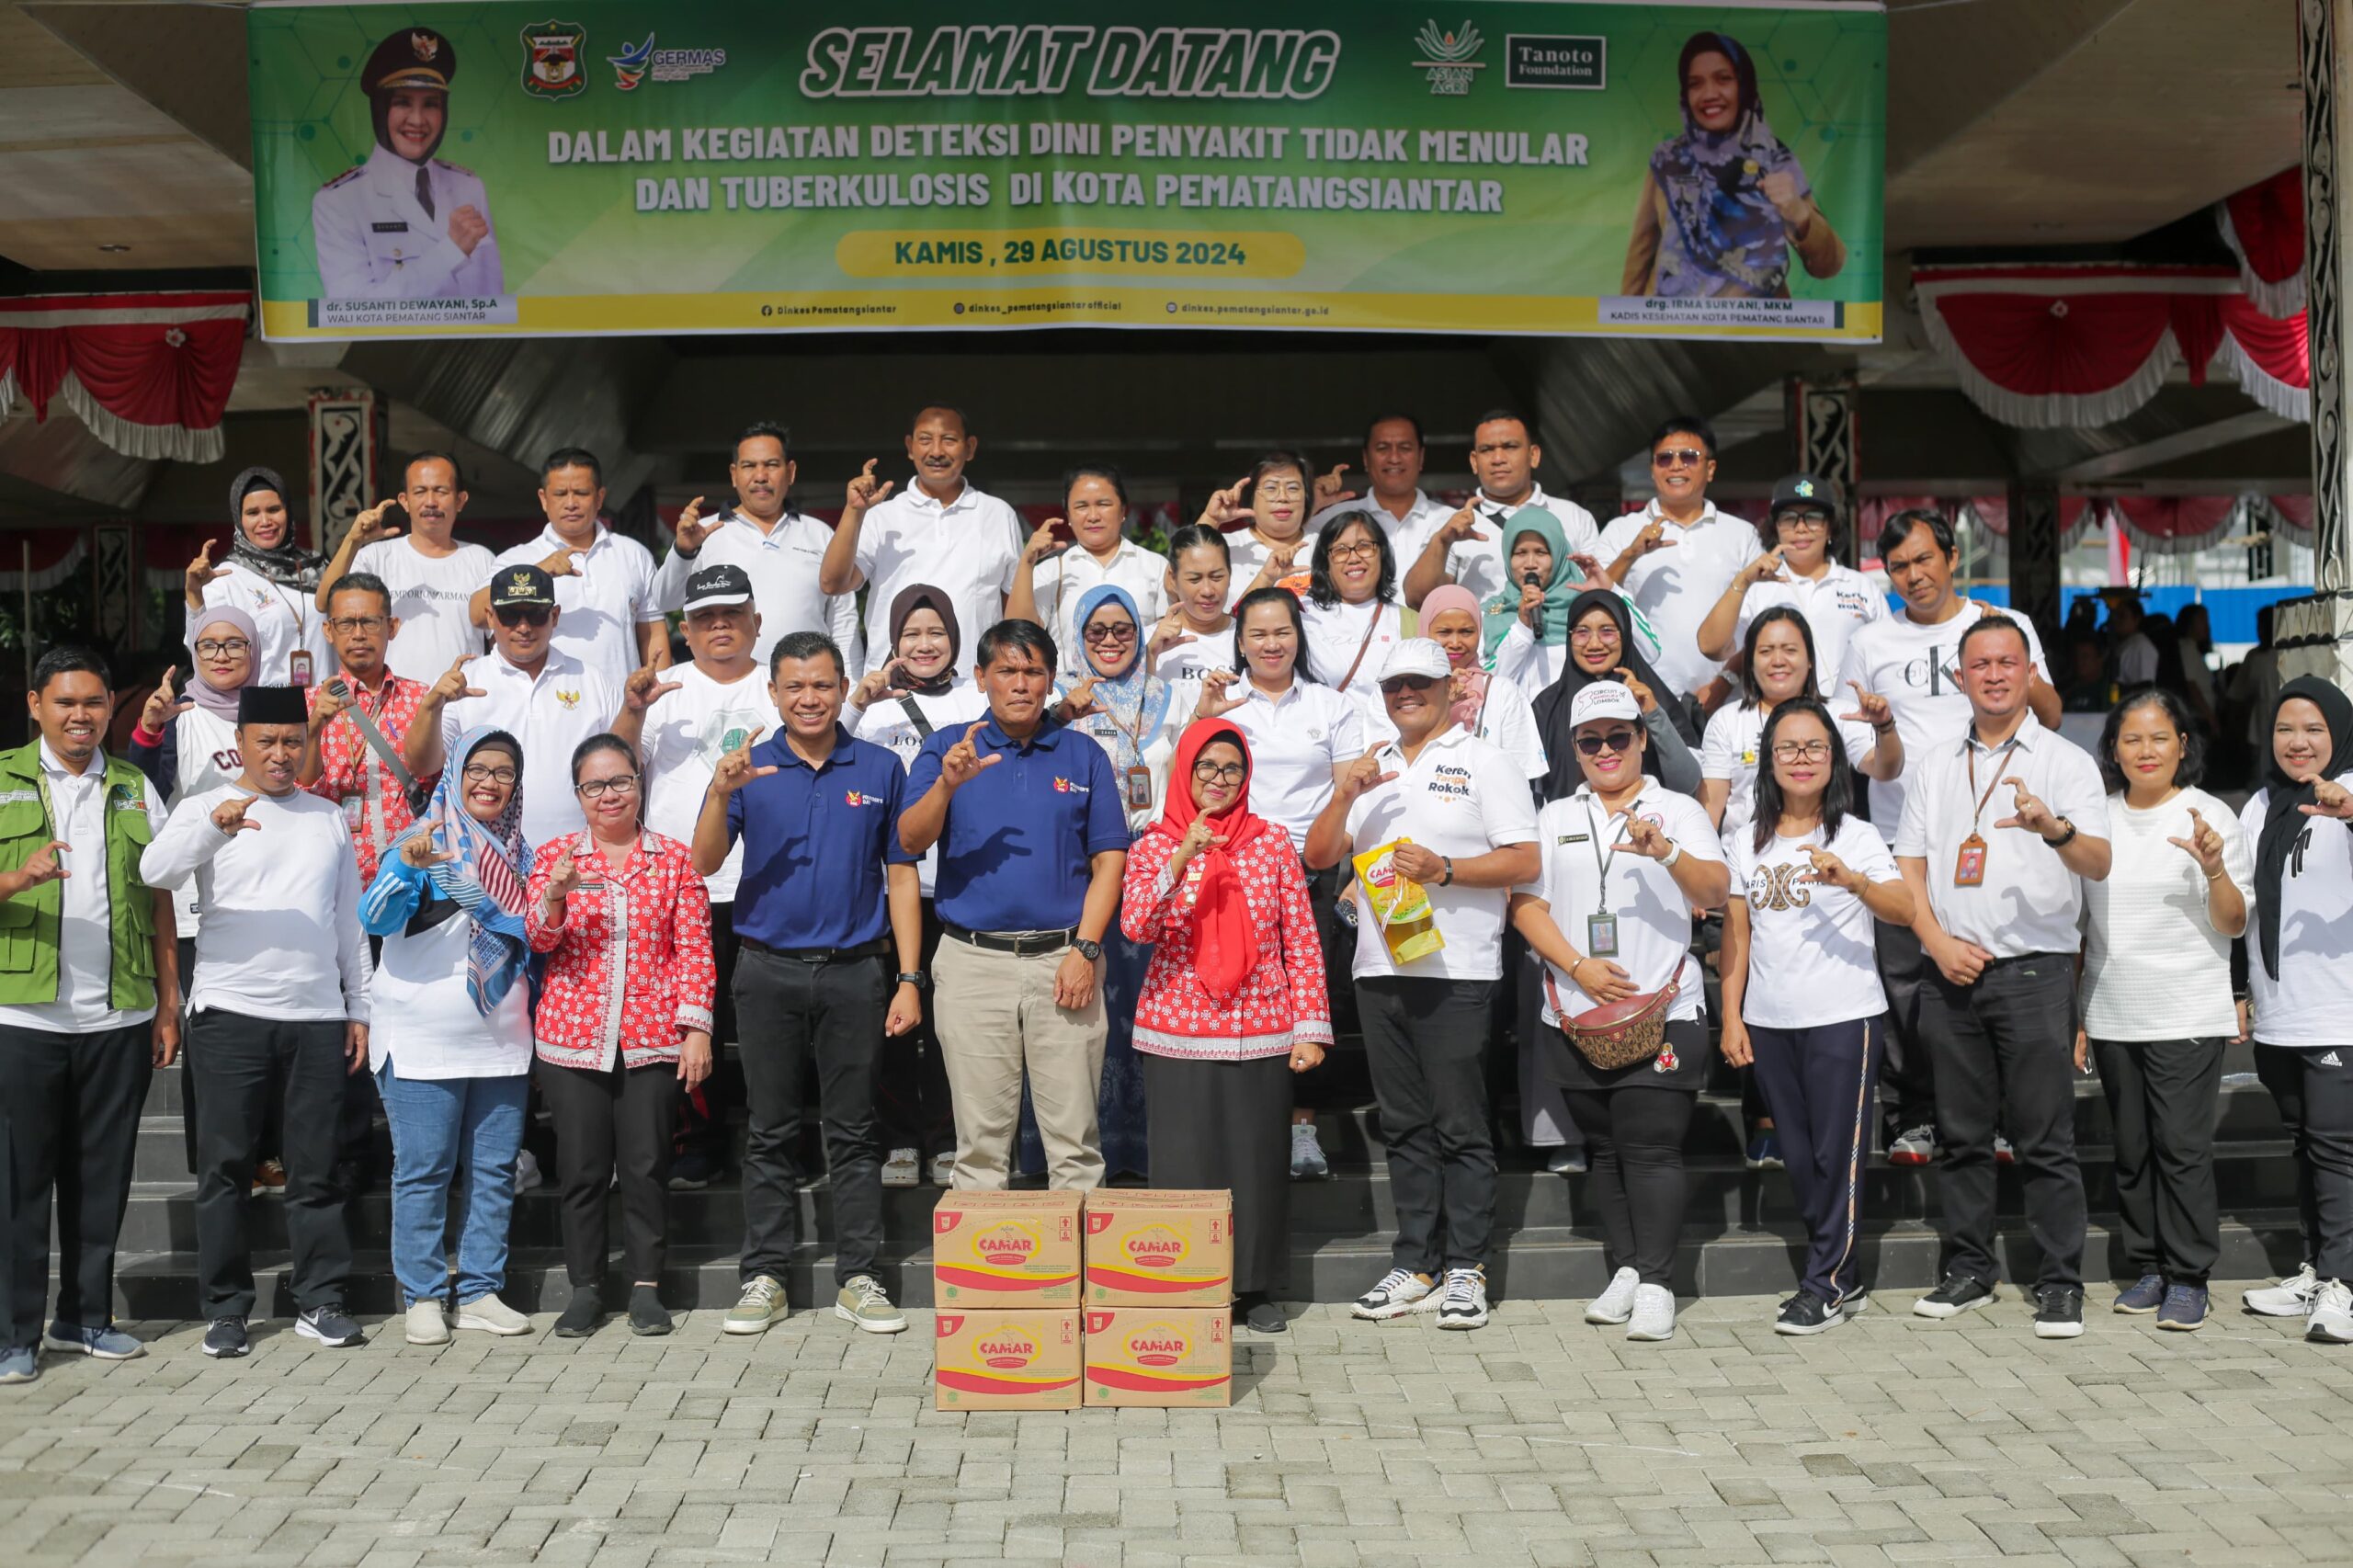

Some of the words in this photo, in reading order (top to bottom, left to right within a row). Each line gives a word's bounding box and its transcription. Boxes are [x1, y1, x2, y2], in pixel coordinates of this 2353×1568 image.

[653, 50, 725, 65] GERMAS
[1518, 46, 1593, 62] Tanoto
[801, 25, 1089, 98] SELAMAT
[1087, 26, 1342, 100] DATANG
[1427, 67, 1473, 81] ASIAN
[1518, 64, 1593, 76] Foundation
[1430, 81, 1468, 95] AGRI
[549, 129, 672, 163] DALAM
[682, 126, 859, 160] KEGIATAN
[870, 123, 1019, 157] DETEKSI
[1030, 122, 1100, 155] DINI
[1112, 124, 1289, 159] PENYAKIT
[1300, 127, 1409, 161] TIDAK
[1418, 130, 1589, 165] MENULAR
[635, 176, 709, 210] DAN
[721, 173, 990, 209] TUBERKULOSIS
[1010, 172, 1041, 204] DI
[1052, 170, 1145, 206] KOTA
[1155, 174, 1503, 212] PEMATANGSIANTAR
[894, 241, 983, 265] KAMIS
[1004, 241, 1036, 264] 29
[1040, 238, 1168, 264] AGUSTUS
[1176, 242, 1245, 265] 2024
[326, 301, 342, 312] dr.
[346, 301, 397, 312] SUSANTI
[400, 299, 469, 312] DEWAYANI,
[471, 299, 497, 311] Sp.A
[1181, 303, 1329, 317] dinkes.pematangsiantar.go.id
[1645, 300, 1669, 311] drg.
[1672, 301, 1700, 310] IRMA
[1706, 301, 1761, 311] SURYANI,
[1764, 301, 1792, 311] MKM
[327, 314, 354, 324] WALI
[356, 314, 383, 323] KOTA
[386, 312, 441, 323] PEMATANG
[444, 312, 485, 322] SIANTAR
[1643, 312, 1700, 321] KESEHATAN
[1701, 313, 1728, 322] KOTA
[1730, 314, 1782, 324] PEMATANG
[1785, 315, 1824, 324] SIANTAR
[390, 589, 429, 598] EMPORIO
[438, 591, 470, 602] ARMAN
[1435, 765, 1472, 779] Keren
[1427, 782, 1470, 796] Rokok
[978, 1239, 1033, 1251] CAMAR
[1128, 1241, 1182, 1253] CAMAR
[979, 1342, 1034, 1354] CAMAR
[1131, 1339, 1184, 1352] CAMAR
